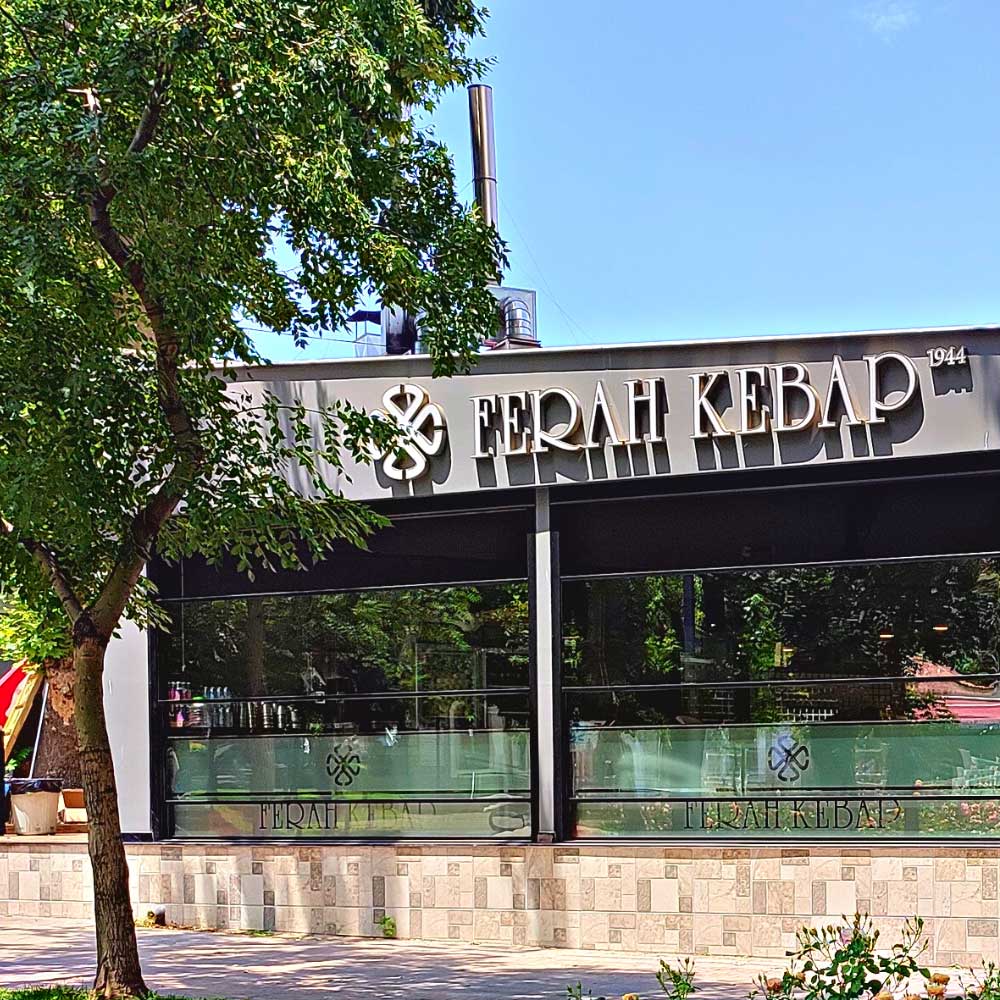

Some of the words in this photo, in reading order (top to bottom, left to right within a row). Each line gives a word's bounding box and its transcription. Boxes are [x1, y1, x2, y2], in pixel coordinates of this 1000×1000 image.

[926, 346, 967, 368] 1944
[468, 377, 664, 458] FERAH
[689, 351, 921, 438] KEBAP
[259, 801, 339, 830] FERAH
[683, 800, 782, 830] FERAH
[791, 800, 901, 830] KEBAP
